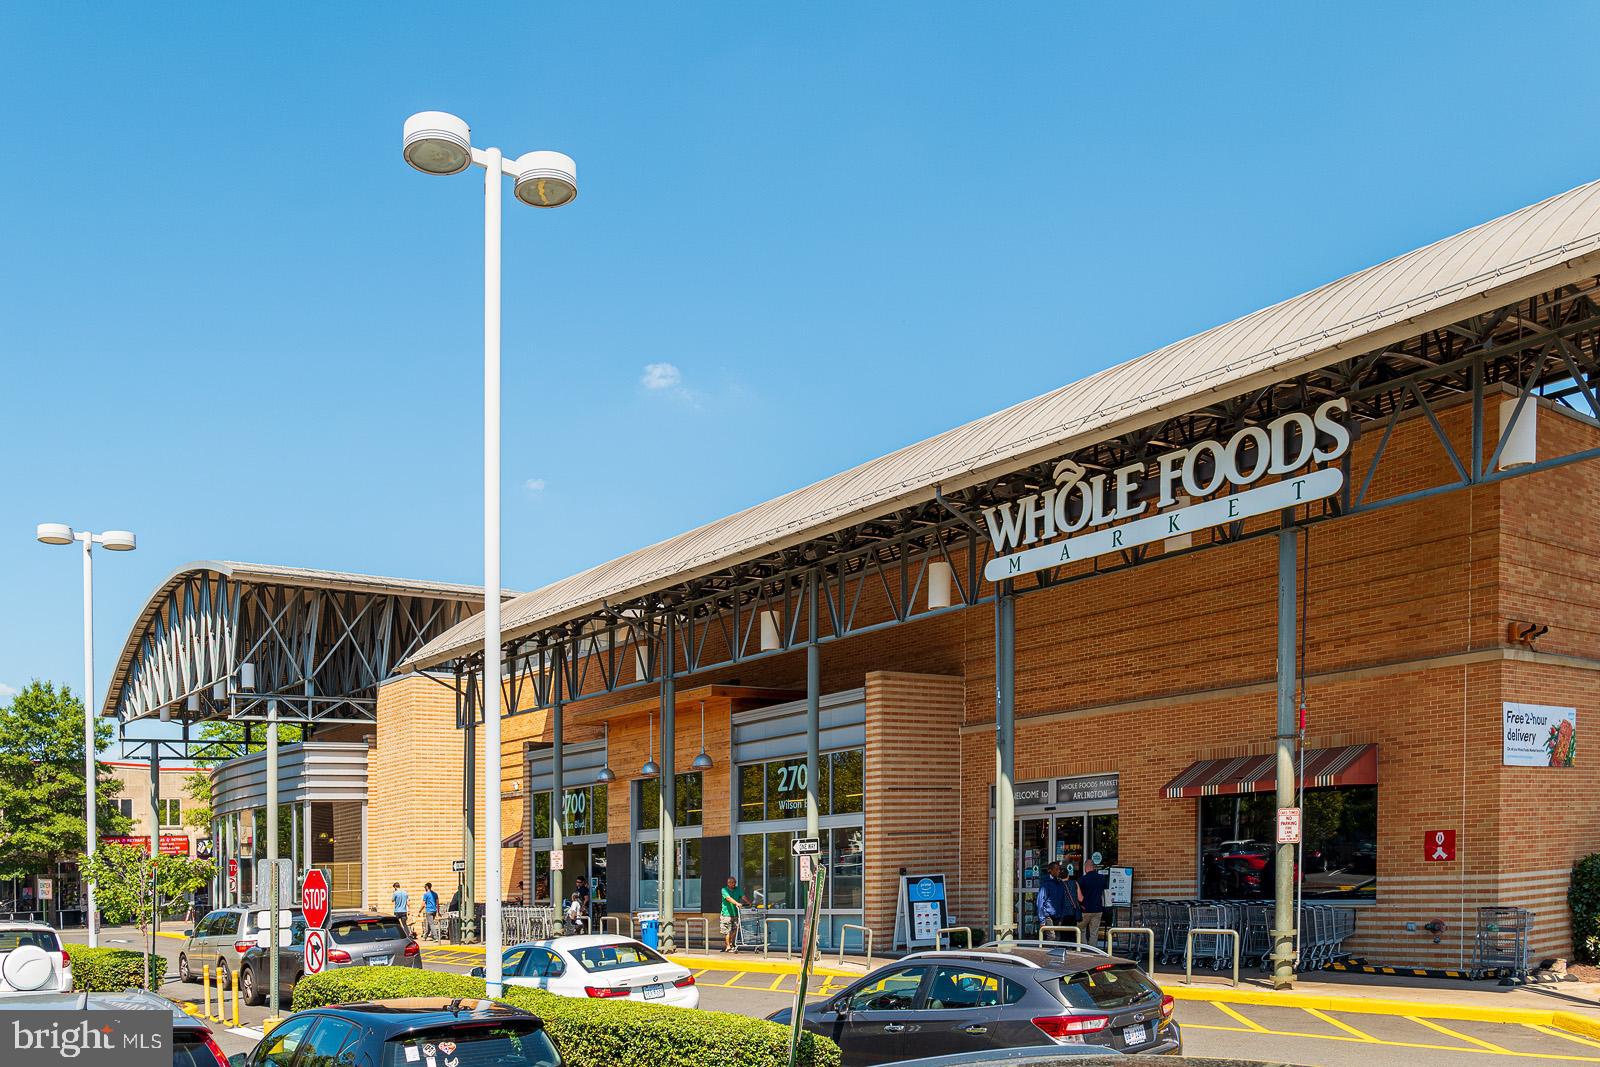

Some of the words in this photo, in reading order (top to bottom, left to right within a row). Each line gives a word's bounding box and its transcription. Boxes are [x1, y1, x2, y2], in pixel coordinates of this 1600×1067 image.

[982, 459, 1150, 553] WHOLE
[1156, 397, 1352, 508] FOODS
[1008, 480, 1306, 573] MARKET
[1506, 710, 1524, 724] Free
[1525, 712, 1548, 725] 2-hour
[1507, 728, 1536, 745] delivery
[1079, 781, 1097, 789] FOODS
[1099, 779, 1118, 787] MARKET
[1073, 790, 1108, 800] ARLINGTON
[779, 798, 802, 810] Wilson
[304, 888, 326, 910] STOP
